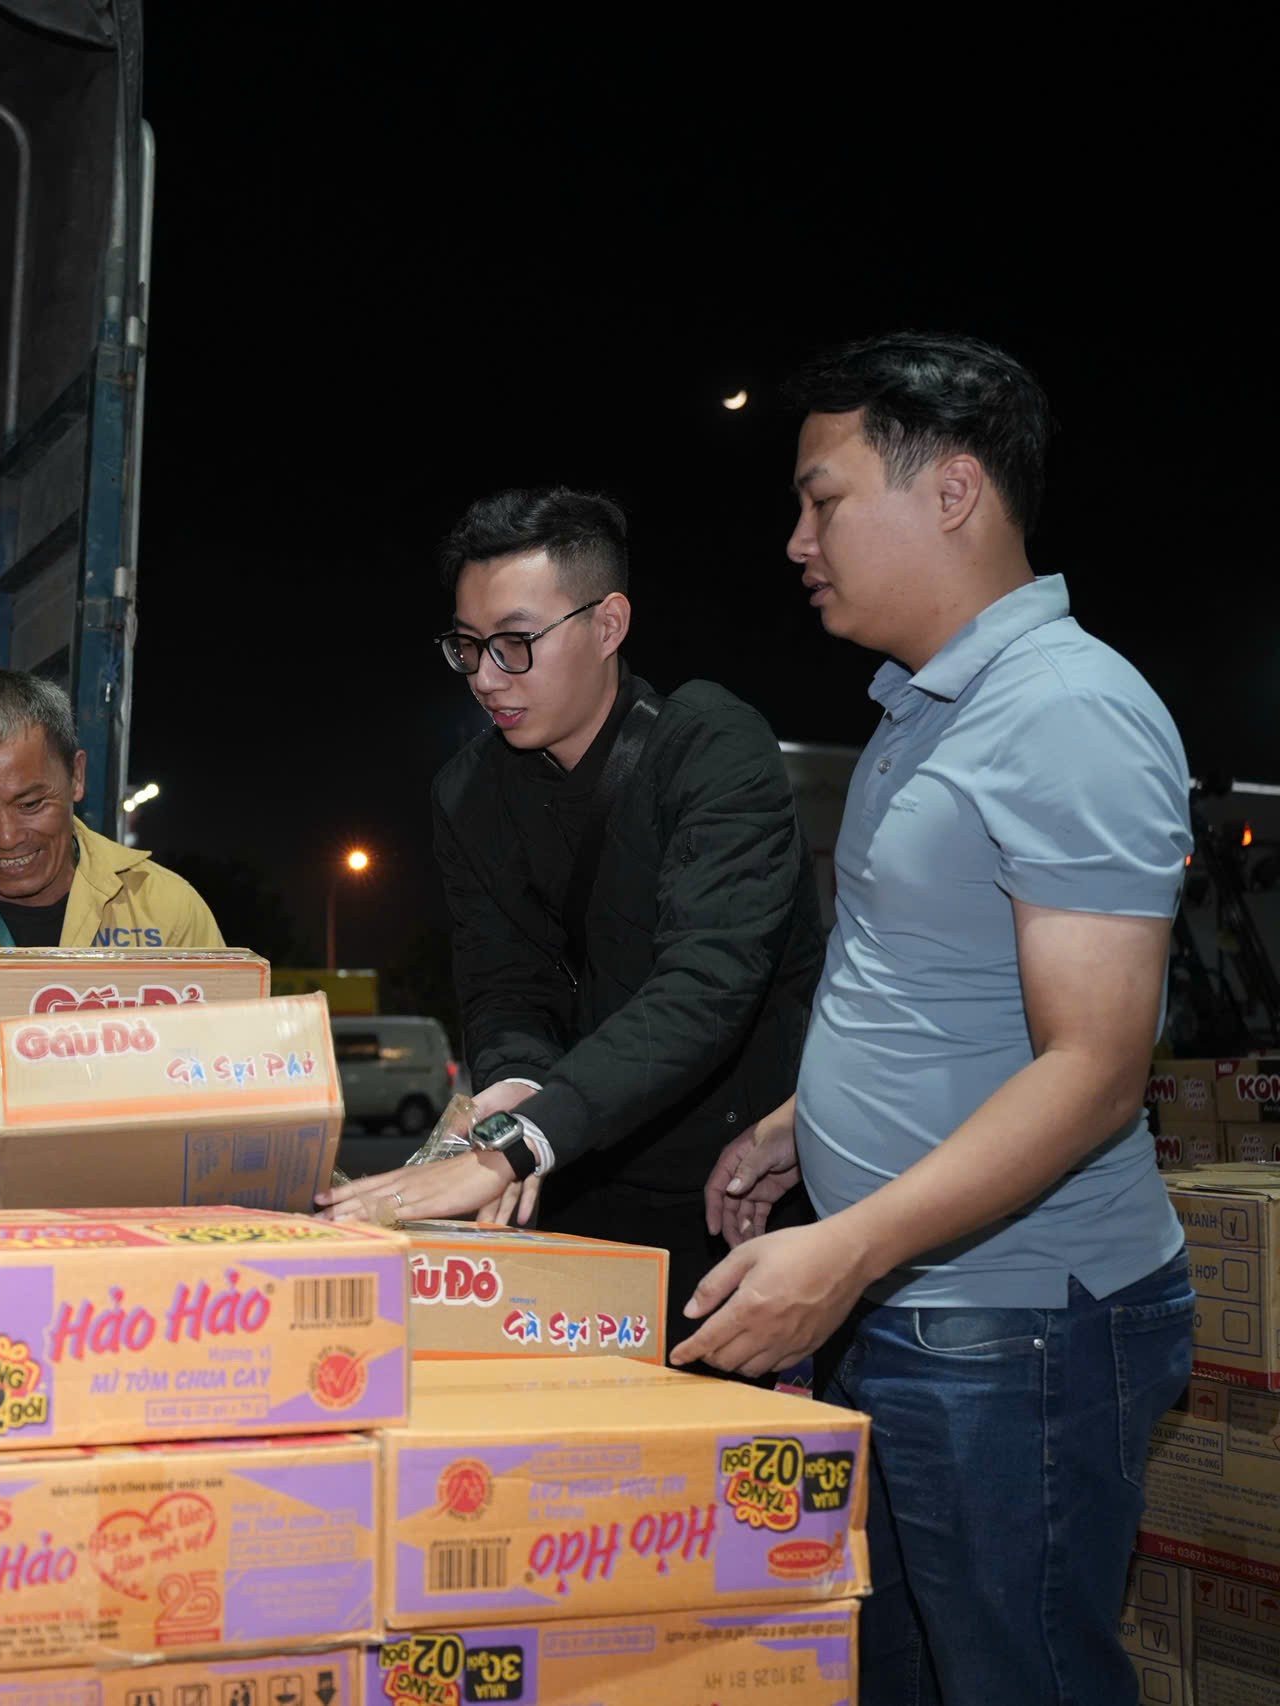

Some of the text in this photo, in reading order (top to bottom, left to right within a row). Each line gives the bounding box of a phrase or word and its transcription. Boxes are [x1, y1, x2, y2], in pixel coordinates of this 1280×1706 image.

[92, 928, 162, 947] NCTS
[1187, 1212, 1218, 1229] XANH
[50, 1267, 271, 1363] Hảo Hảo
[502, 1309, 649, 1351] Gà Sợi Phở
[233, 1366, 273, 1388] CAY
[753, 1440, 803, 1488] 02
[528, 1503, 718, 1596] Hảo Hảo
[156, 1570, 222, 1628] 25
[411, 1637, 462, 1680] 02
